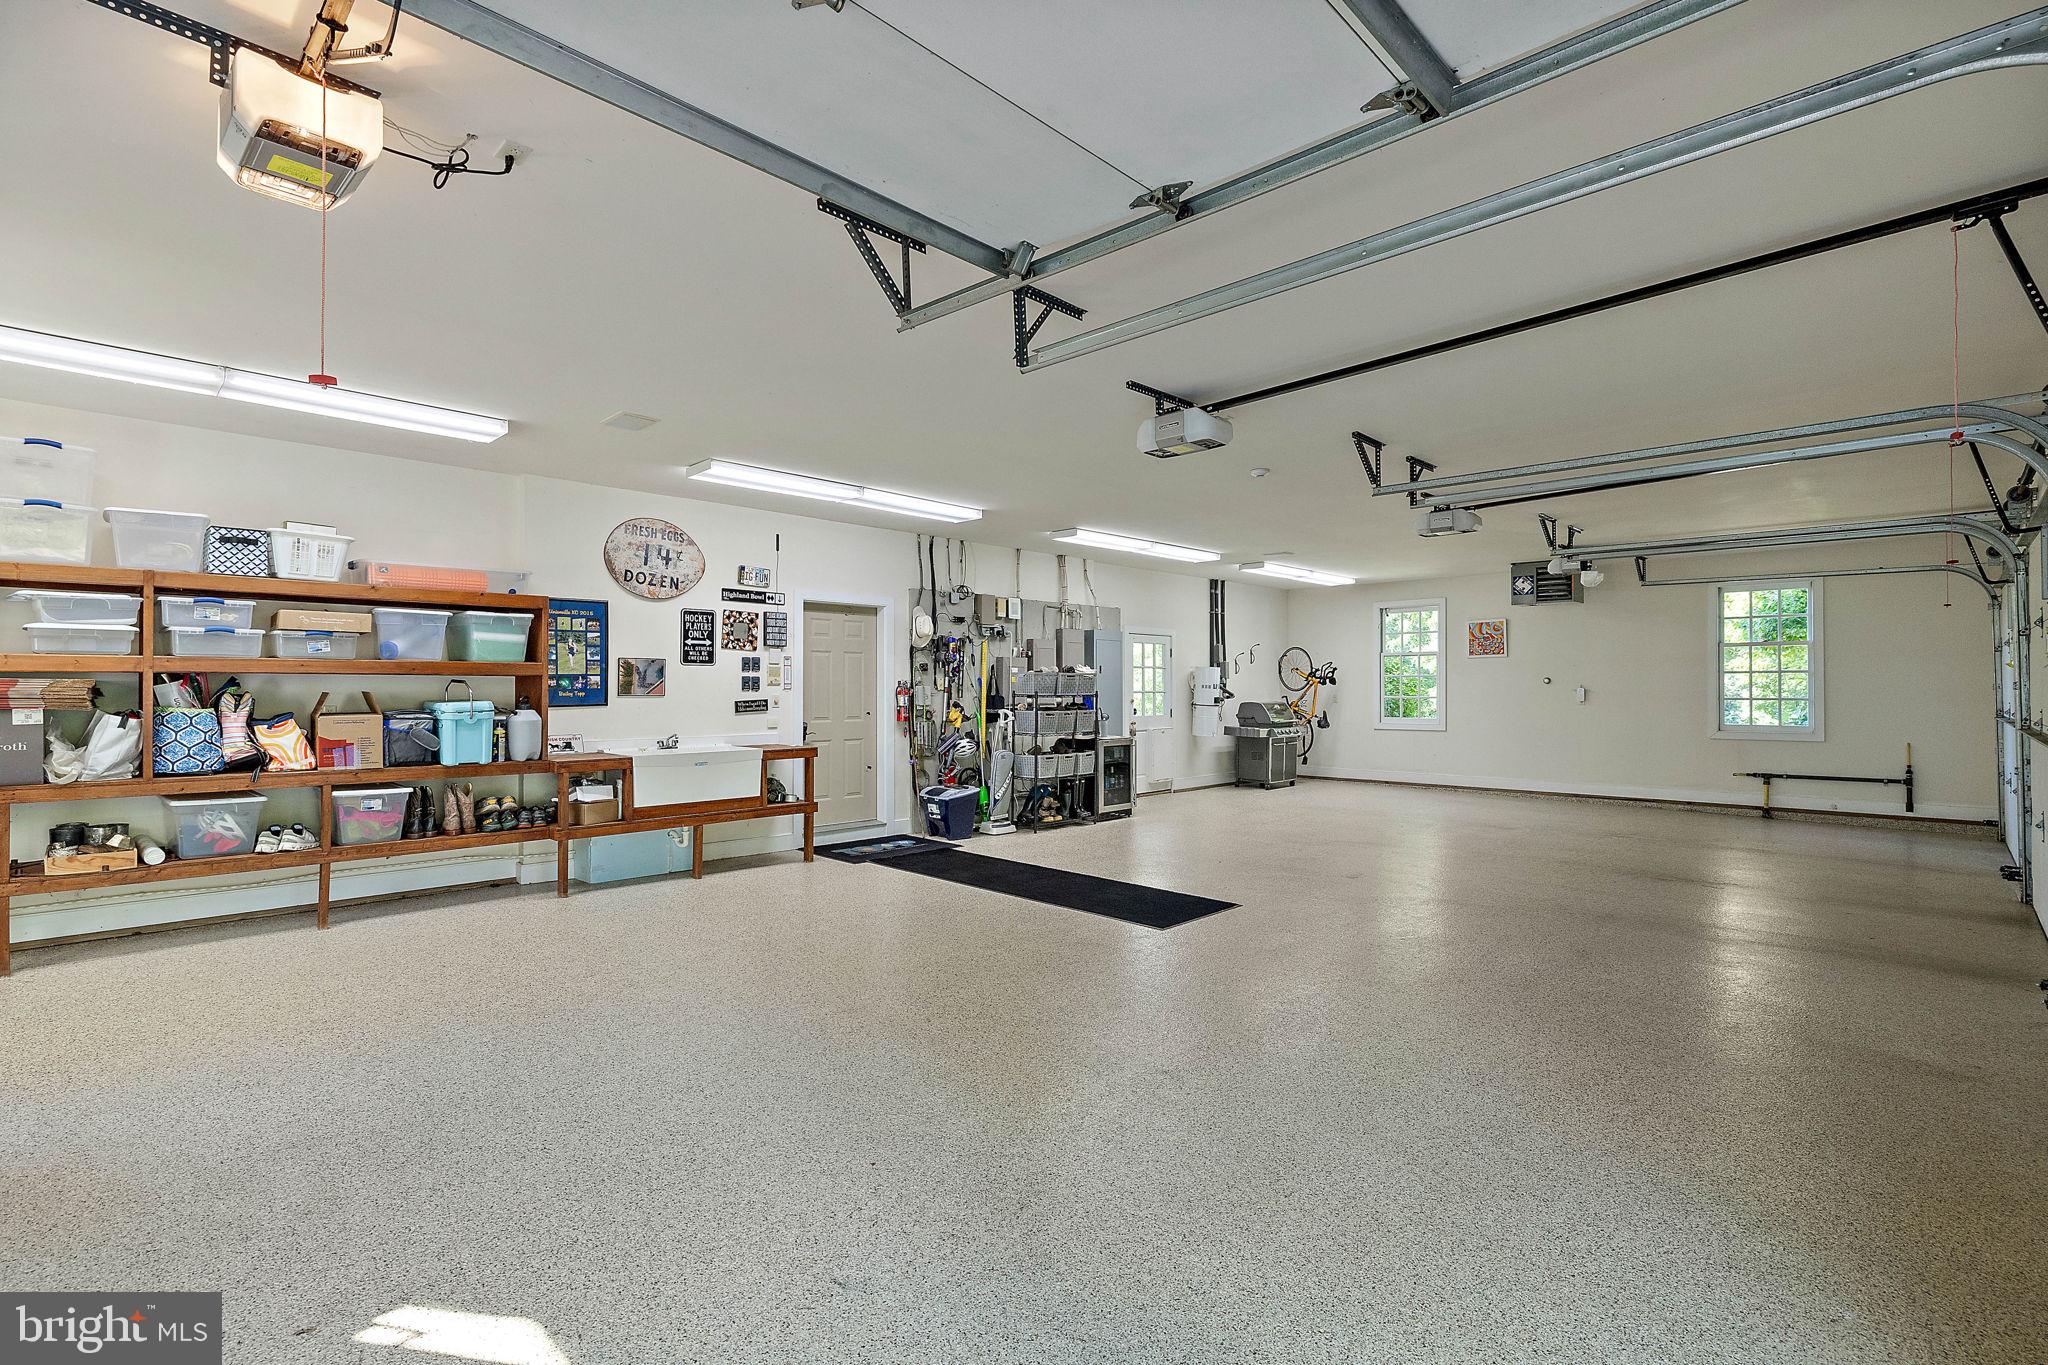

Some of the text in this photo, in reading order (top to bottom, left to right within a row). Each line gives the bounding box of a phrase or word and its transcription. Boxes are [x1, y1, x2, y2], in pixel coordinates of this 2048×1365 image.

[624, 524, 685, 543] FRESH EGGS
[624, 569, 680, 590] DOZEN
[685, 614, 712, 623] HOCKEY
[685, 622, 712, 631] PLAYERS
[688, 630, 709, 639] ONLY
